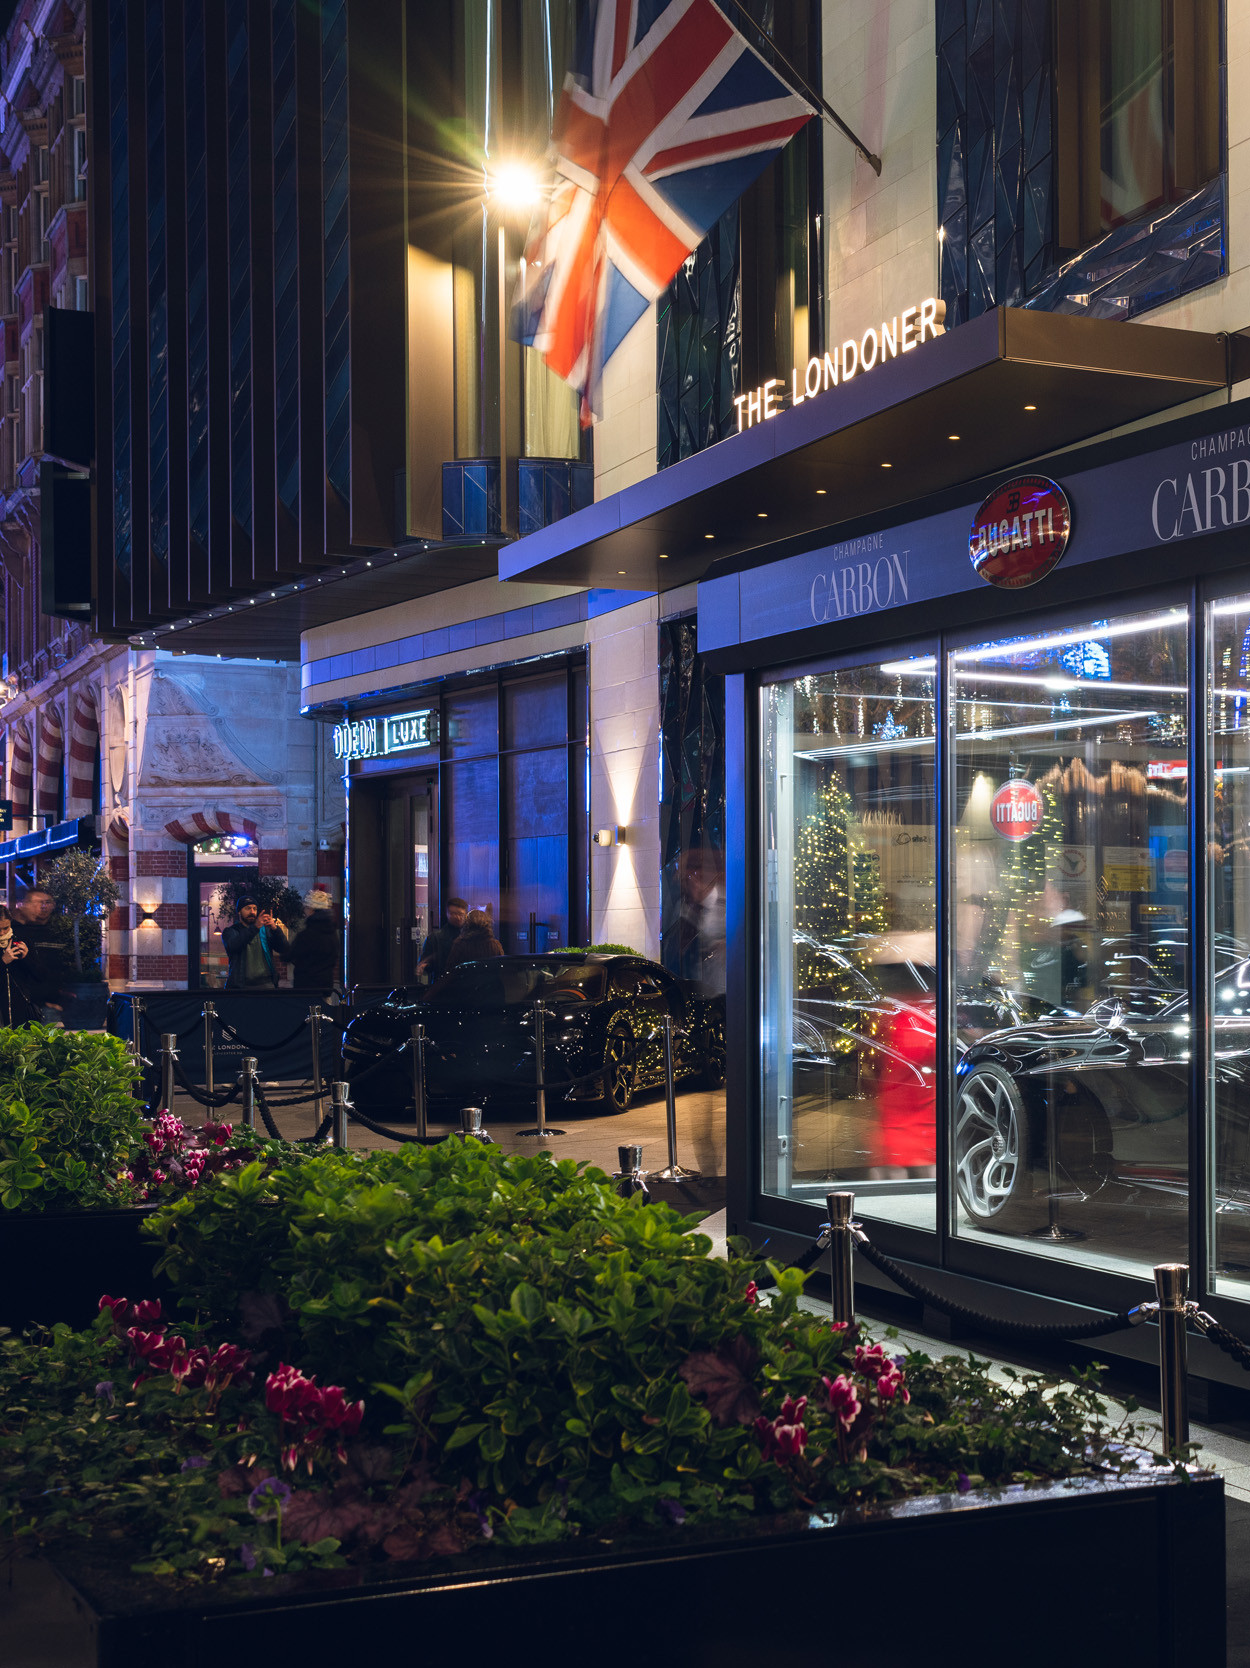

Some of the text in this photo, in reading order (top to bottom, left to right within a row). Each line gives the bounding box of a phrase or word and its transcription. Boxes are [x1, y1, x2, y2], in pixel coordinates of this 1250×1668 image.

[734, 297, 938, 432] THE LONDONER
[833, 533, 884, 561] CHAMPAGNE
[978, 507, 1054, 557] BUGATTI
[810, 549, 911, 623] CARBON
[333, 717, 427, 760] ODEON LUXE
